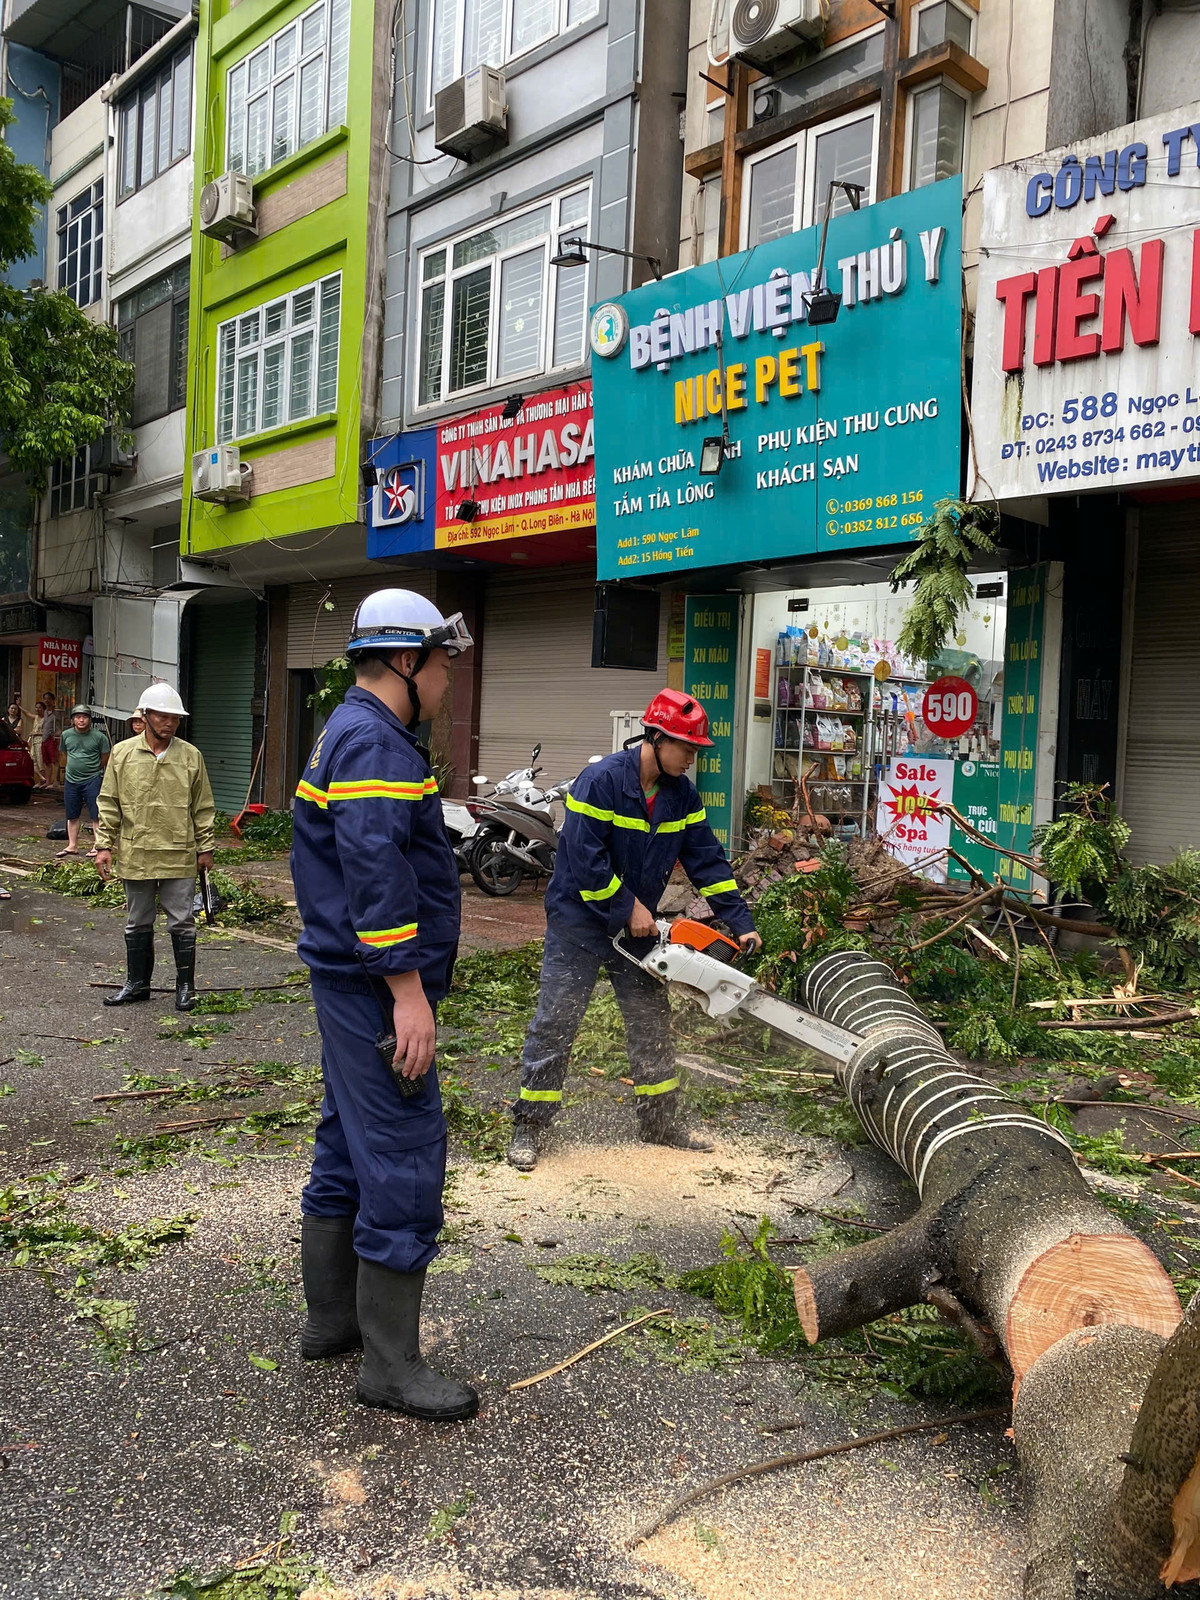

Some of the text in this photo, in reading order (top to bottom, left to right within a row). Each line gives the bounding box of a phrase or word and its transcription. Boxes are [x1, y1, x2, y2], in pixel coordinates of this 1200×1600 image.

[1025, 142, 1148, 218] CÔNG
[629, 299, 723, 372] BỆNH
[725, 267, 827, 338] VIỆN
[918, 226, 946, 282] Y
[996, 214, 1165, 374] TIẾN
[674, 341, 825, 425] NICE PET
[441, 426, 457, 445] CÔNG
[458, 424, 466, 440] TY
[467, 420, 484, 438] TNHH
[484, 411, 498, 434] SẢN
[525, 401, 553, 423] THƯƠNG
[555, 397, 570, 417] MẠI
[1022, 387, 1200, 431] ĐC: 588 Ngọc L
[757, 428, 792, 453] PHỤ
[796, 418, 837, 446] KIỆN
[883, 397, 938, 427] CƯNG
[440, 418, 595, 491] VINAHASA
[1001, 441, 1030, 460] ĐT:
[1035, 434, 1077, 454] 0243
[1082, 426, 1125, 448] 8734
[1129, 420, 1166, 441] 662
[613, 460, 654, 484] KHÁM
[658, 449, 696, 474] CHỮA
[756, 453, 859, 490] KHÁCH SẠN
[1037, 455, 1128, 483] Website:
[490, 494, 506, 515] KIỆN
[507, 492, 524, 510] INOX
[524, 487, 548, 507] PHÒNG
[549, 480, 564, 502] TẮM
[565, 478, 581, 499] NHÀ
[613, 481, 715, 517] TẮM TỈA LÔNG
[875, 494, 898, 508] 868
[901, 489, 924, 505] 156
[470, 527, 481, 539] 592
[482, 525, 500, 539] Ngọc
[501, 522, 515, 535] Lâm
[548, 513, 564, 527] Biên
[570, 510, 581, 523] Hà
[582, 508, 595, 523] Nội
[875, 515, 898, 530] 812
[901, 511, 924, 527] 686
[641, 533, 656, 545] 590
[658, 531, 679, 543] Ngọc
[681, 527, 700, 539] Lâm
[618, 554, 640, 566] Add2:
[641, 552, 651, 563] 15
[675, 545, 694, 558] Tiến
[43, 639, 78, 652] NHÀ MAY
[708, 644, 729, 663] MÁU
[41, 652, 79, 669] UYÊN
[691, 681, 729, 700] SIÊU ÂM
[927, 692, 972, 723] 590
[712, 716, 731, 737] SẢN
[895, 762, 937, 782] Sale
[1003, 750, 1017, 773] PHỤ
[895, 794, 933, 816] 10%
[968, 805, 988, 817] TRỰC
[895, 823, 928, 843] Spa
